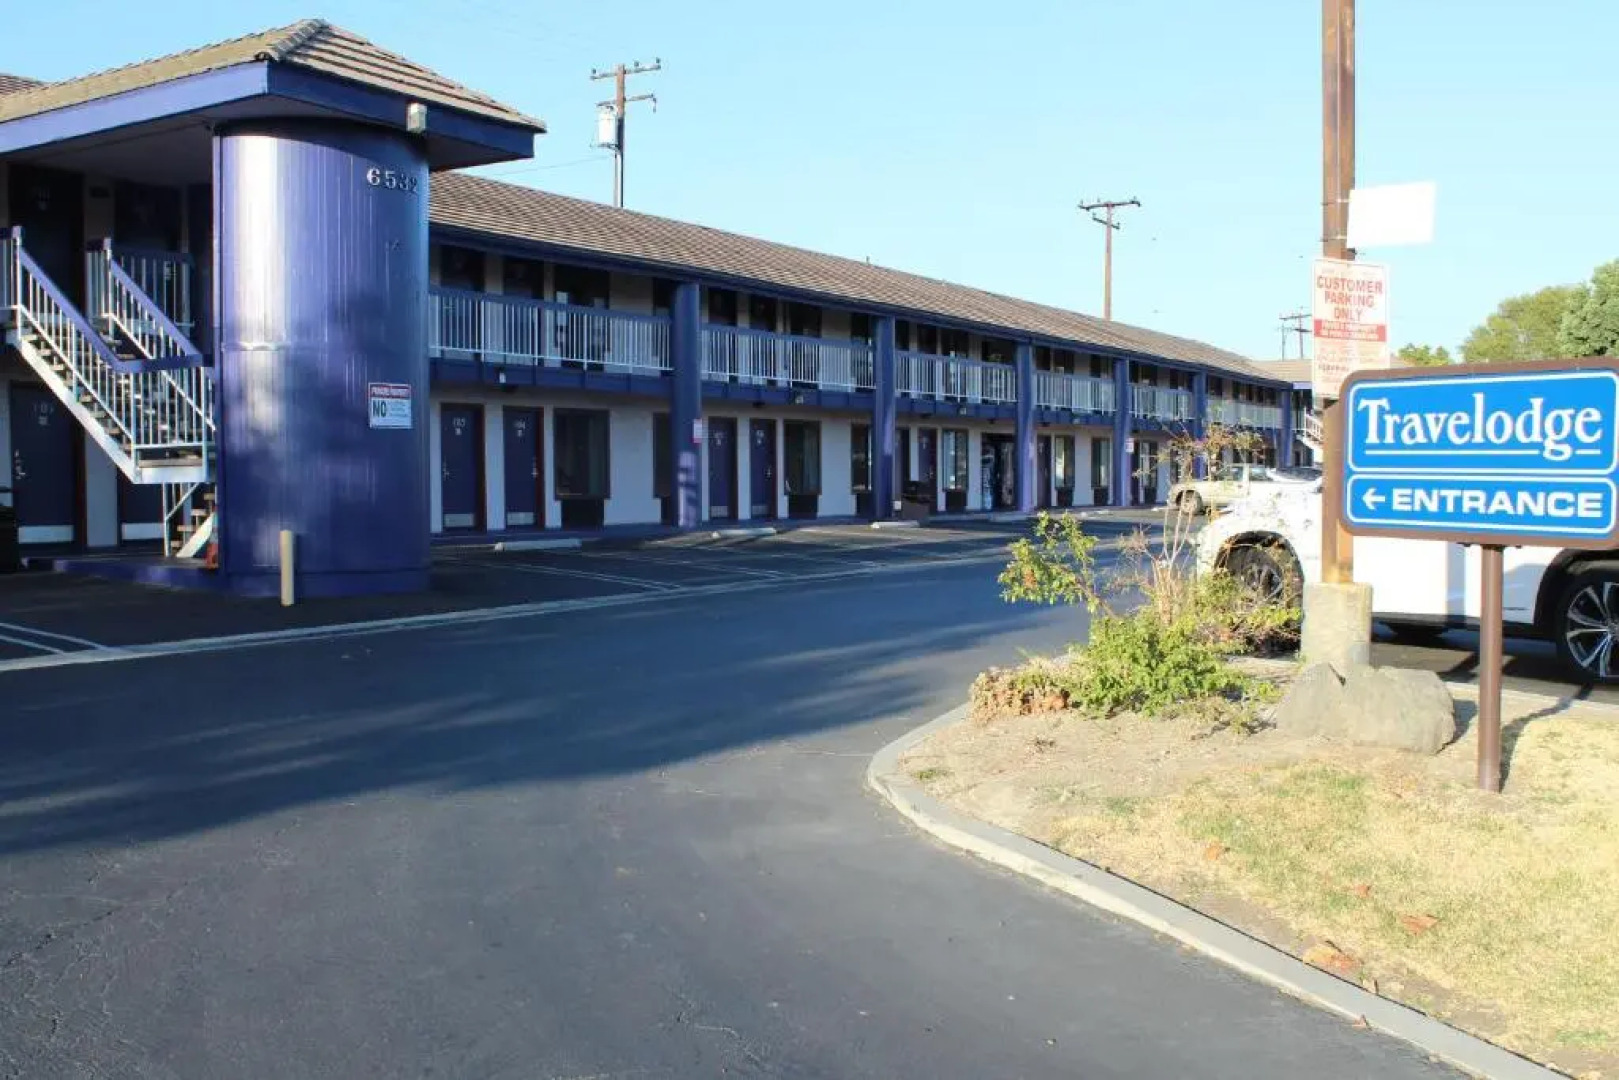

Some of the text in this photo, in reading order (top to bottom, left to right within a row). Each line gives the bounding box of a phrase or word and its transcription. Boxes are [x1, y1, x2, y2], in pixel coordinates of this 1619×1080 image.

[1316, 275, 1384, 294] CUSTOMER
[1324, 290, 1375, 308] PARKING
[1333, 307, 1363, 322] ONLY
[372, 399, 387, 418] NO
[1357, 392, 1603, 461] Travelodge
[1391, 488, 1604, 518] ENTRANCE
